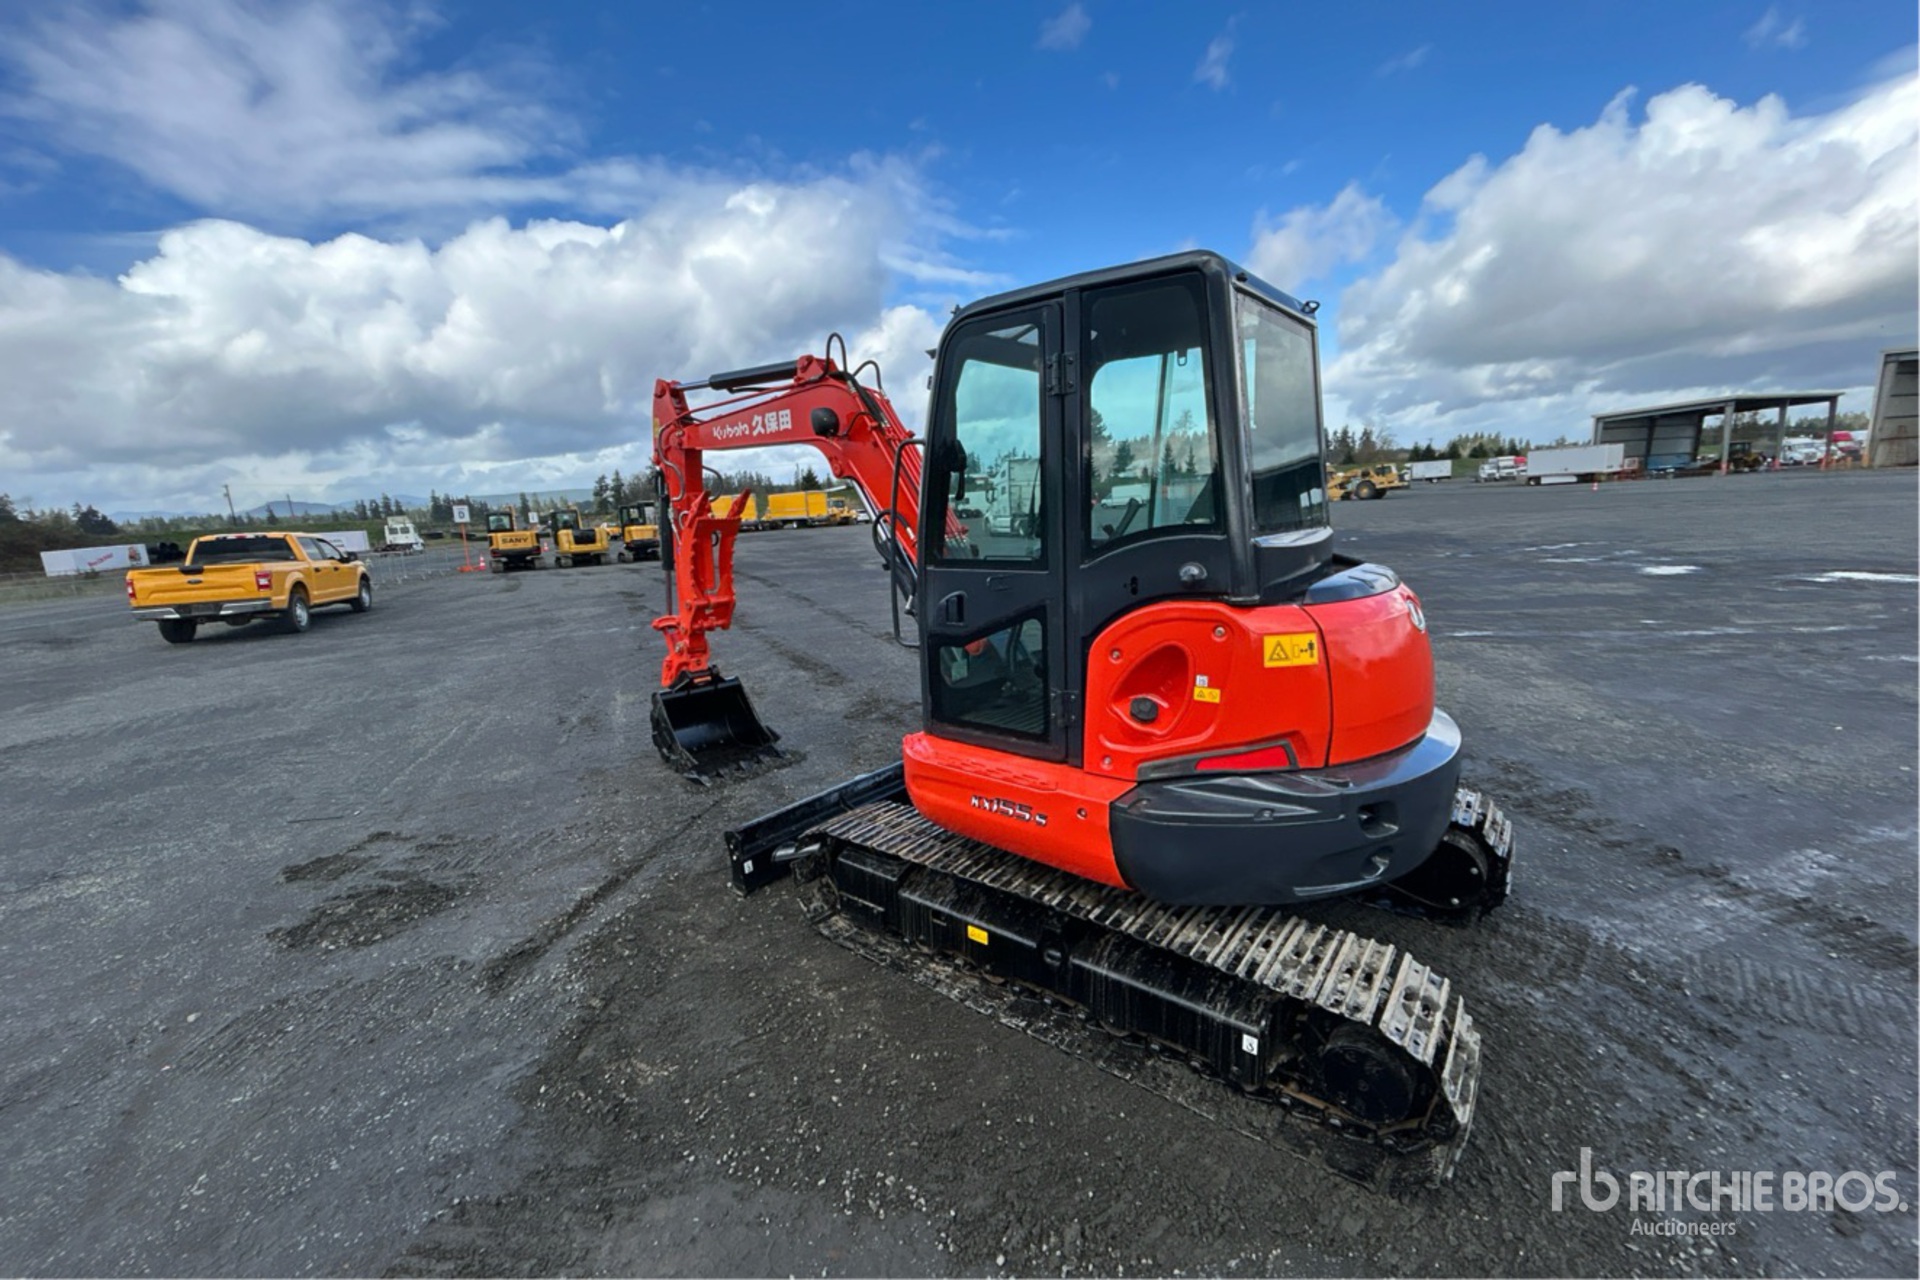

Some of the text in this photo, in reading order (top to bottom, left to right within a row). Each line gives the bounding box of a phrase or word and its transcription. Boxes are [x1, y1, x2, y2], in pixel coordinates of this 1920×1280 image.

[713, 408, 793, 441] Kubota 久保田
